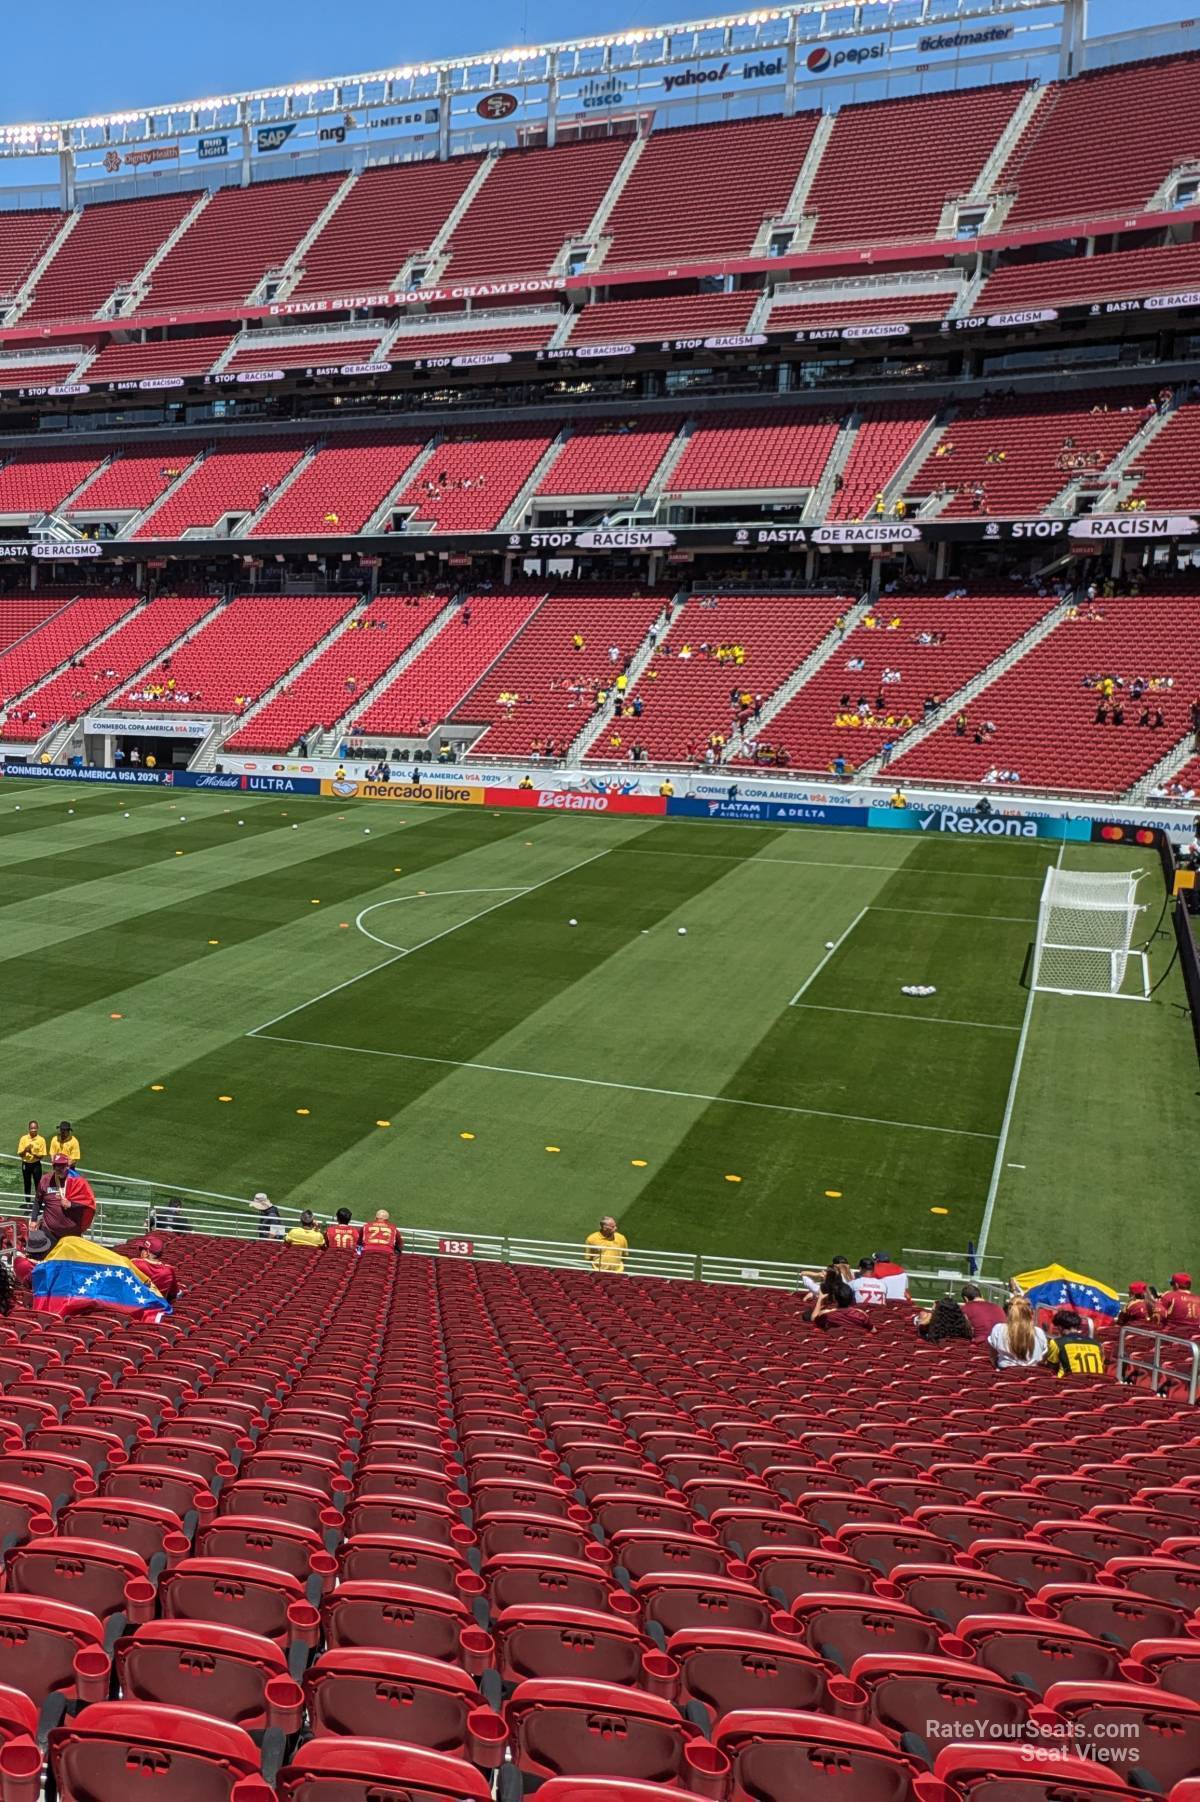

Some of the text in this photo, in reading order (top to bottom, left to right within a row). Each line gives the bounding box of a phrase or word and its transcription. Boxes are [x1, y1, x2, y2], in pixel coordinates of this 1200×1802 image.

[920, 26, 1012, 51] ticketmaster
[833, 43, 885, 67] pepsi
[743, 57, 782, 79] intel
[663, 63, 730, 91] yahoo!
[583, 93, 622, 108] cisco
[370, 114, 421, 128] UNITED
[258, 130, 286, 148] SAP
[320, 127, 345, 142] nrg
[203, 138, 222, 147] BUD
[125, 148, 178, 165] Dignity Health
[200, 147, 227, 157] LIGHT
[270, 278, 567, 315] 5-TIME SUPER BOWL CHAMPIONS
[1107, 294, 1200, 312] BASTA DE RACIS
[956, 312, 1042, 328] STOP RACISM
[809, 331, 839, 340] BASTA
[864, 326, 905, 335] RACISMO
[675, 336, 753, 349] STOP RACISM
[548, 345, 631, 359] BASTA DE RACISMO
[426, 356, 495, 367] STOP RACISM
[316, 367, 338, 375] BASTA
[358, 364, 388, 372] RACISMO
[215, 372, 274, 383] STOP RACISM
[758, 528, 912, 542] BASTA DE RACISMO
[1011, 519, 1168, 537] STOP RACISM
[531, 534, 652, 547] STOP RACISM
[37, 546, 50, 555] DE
[53, 545, 97, 554] RACISMO
[7, 765, 159, 782] CONMEBOL COPA AMERICA USA 2024
[196, 775, 294, 790] Michelob ULTRA
[363, 784, 471, 801] mercado libre
[745, 791, 851, 804] COPA AMERICA USA 2024
[537, 792, 608, 810] Betano
[721, 803, 760, 812] LATAM
[788, 809, 825, 818] DELTA
[940, 813, 1037, 837] Rexona
[368, 1227, 392, 1244] 23
[443, 1241, 468, 1254] 133
[1074, 1352, 1099, 1374] 10
